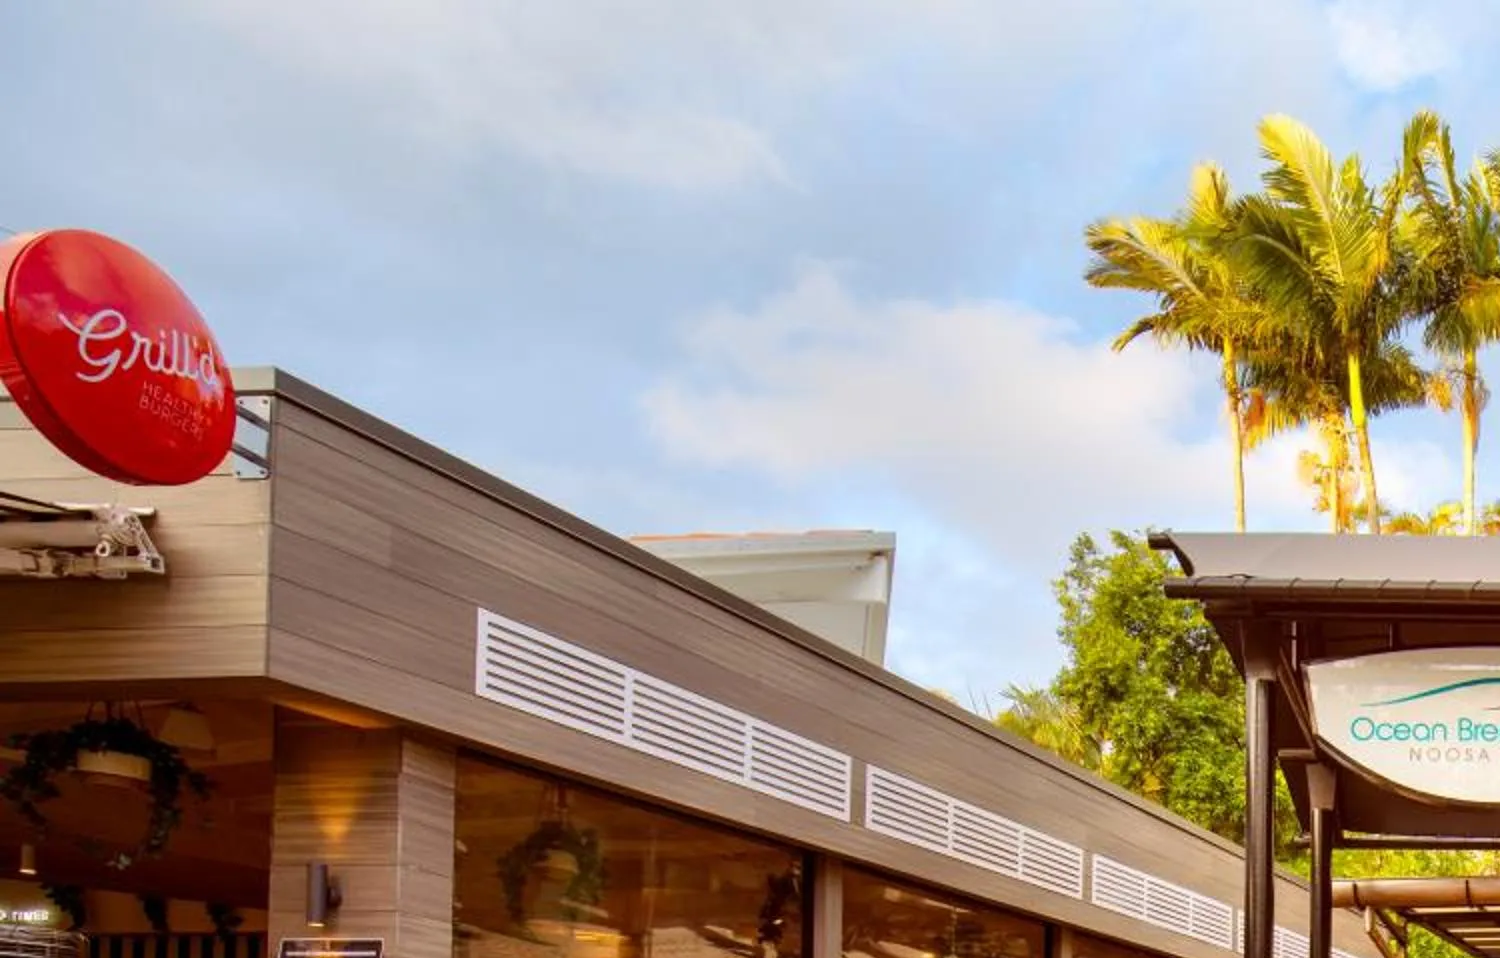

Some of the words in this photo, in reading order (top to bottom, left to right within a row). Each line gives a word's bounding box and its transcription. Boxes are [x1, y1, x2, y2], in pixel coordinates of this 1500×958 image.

[57, 308, 218, 384] Grill'd
[1350, 716, 1448, 743] Ocean
[1408, 747, 1490, 764] NOOSA
